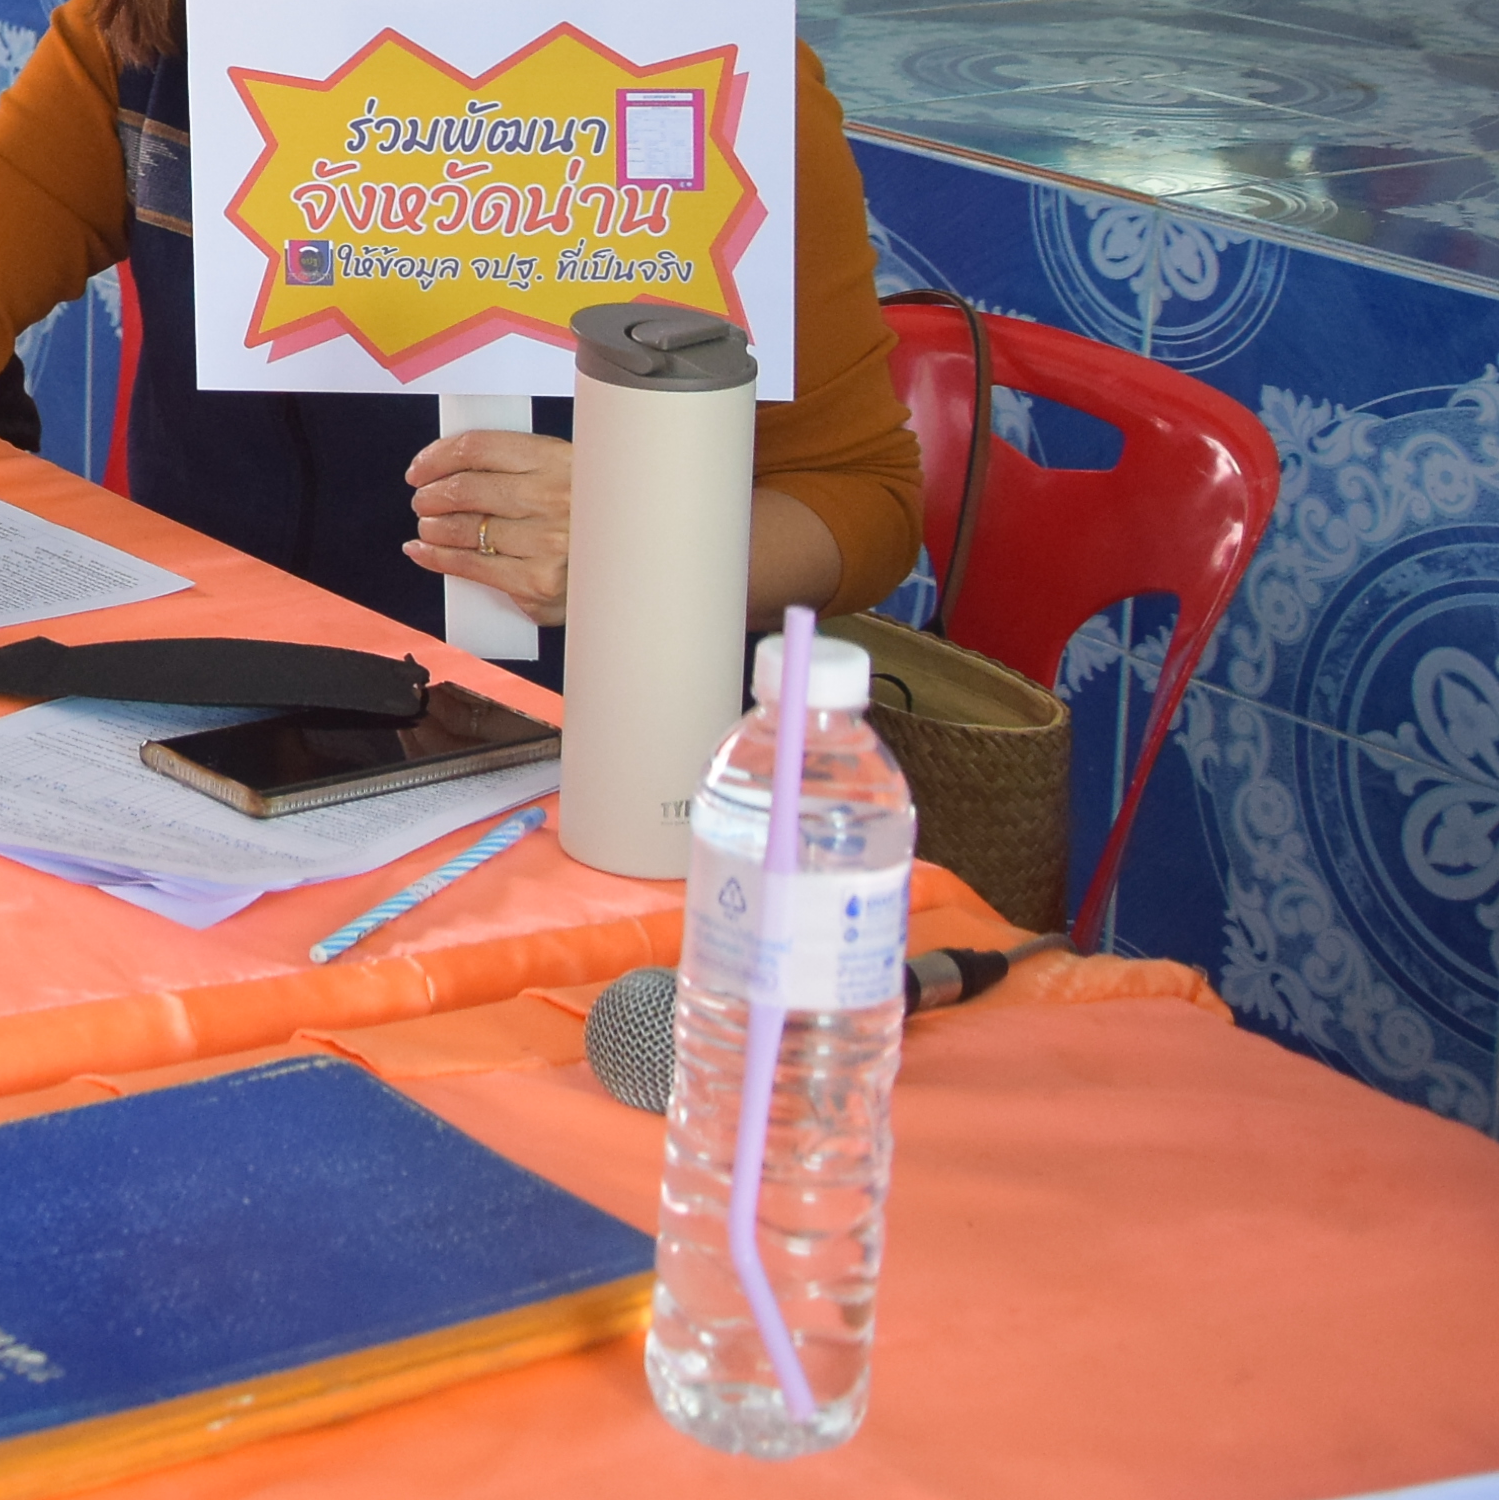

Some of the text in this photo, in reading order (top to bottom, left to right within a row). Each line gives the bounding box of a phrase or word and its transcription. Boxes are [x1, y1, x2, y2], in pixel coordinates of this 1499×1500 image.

[345, 96, 609, 156] ร่วมพัฒนา
[290, 158, 673, 238] จังหวัดน่าน
[336, 236, 695, 291] ให้ข้อมูล จปฐ. ที่เป็นจริง
